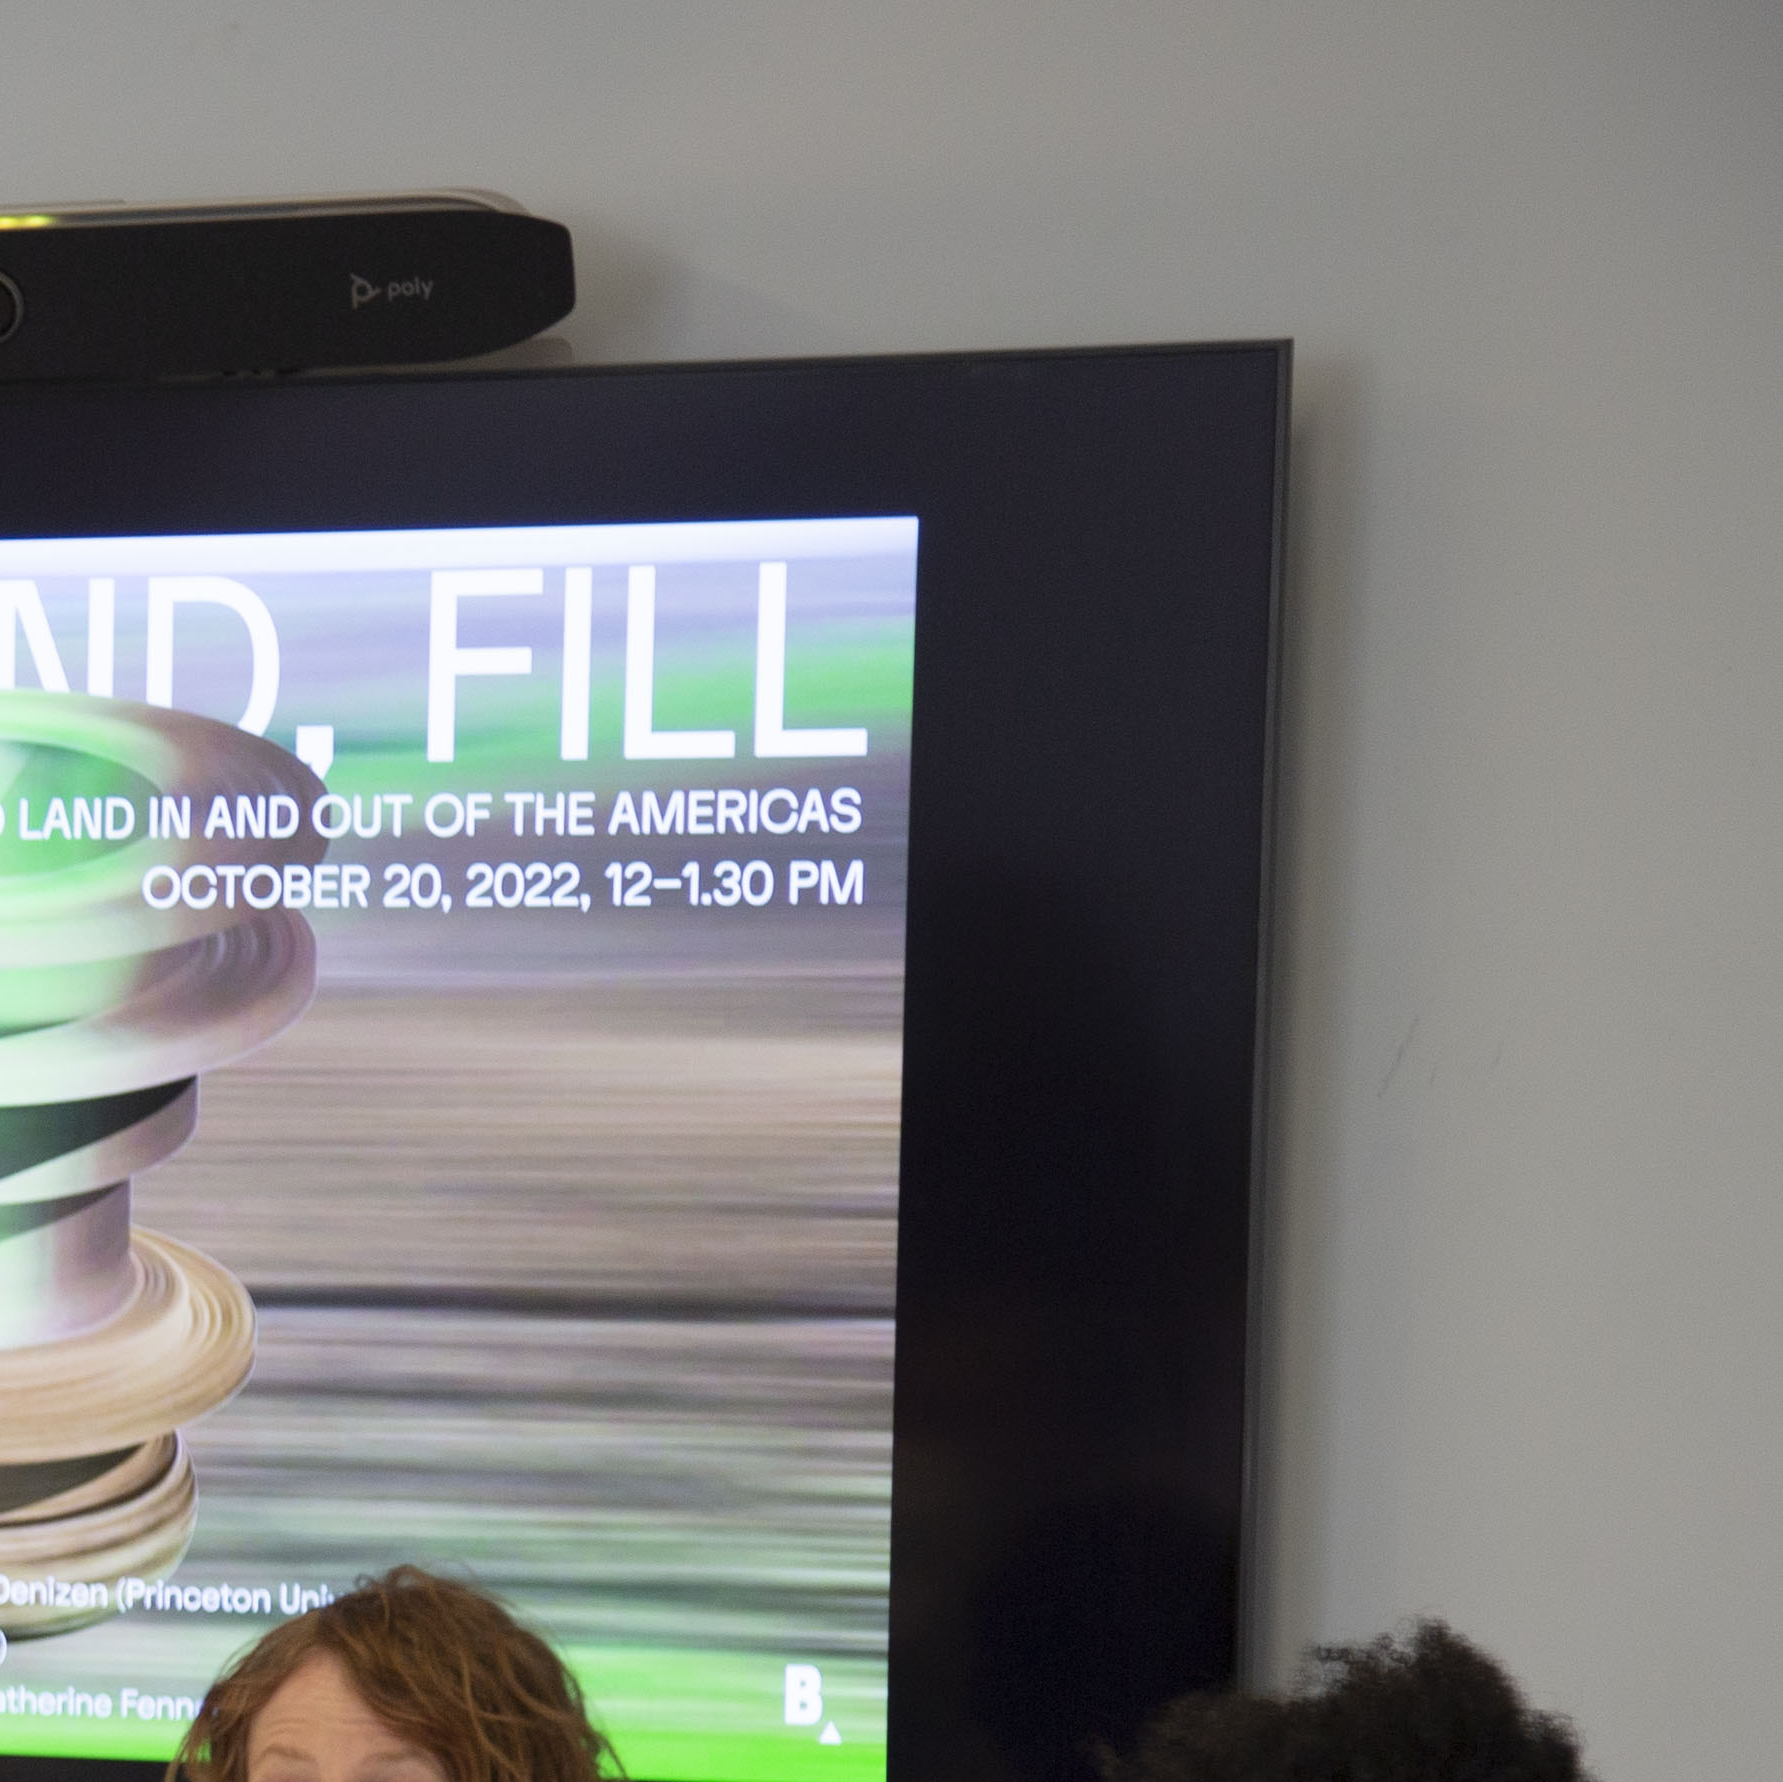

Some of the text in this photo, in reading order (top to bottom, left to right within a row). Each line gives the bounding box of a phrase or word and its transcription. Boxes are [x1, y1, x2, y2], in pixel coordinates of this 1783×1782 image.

[388, 276, 433, 300] poly
[428, 562, 868, 763] FILL
[18, 797, 136, 841] LAND
[148, 796, 191, 840] IN
[204, 795, 300, 839] AND
[311, 794, 414, 838] OUT
[425, 793, 493, 838] OF
[503, 791, 596, 837] THE
[607, 787, 863, 836] AMERICAS
[141, 864, 371, 910] OCTOBER
[383, 862, 453, 914] 20,
[465, 861, 592, 914] 2022,
[788, 859, 865, 906] PM
[115, 1576, 271, 1614] (Princeton
